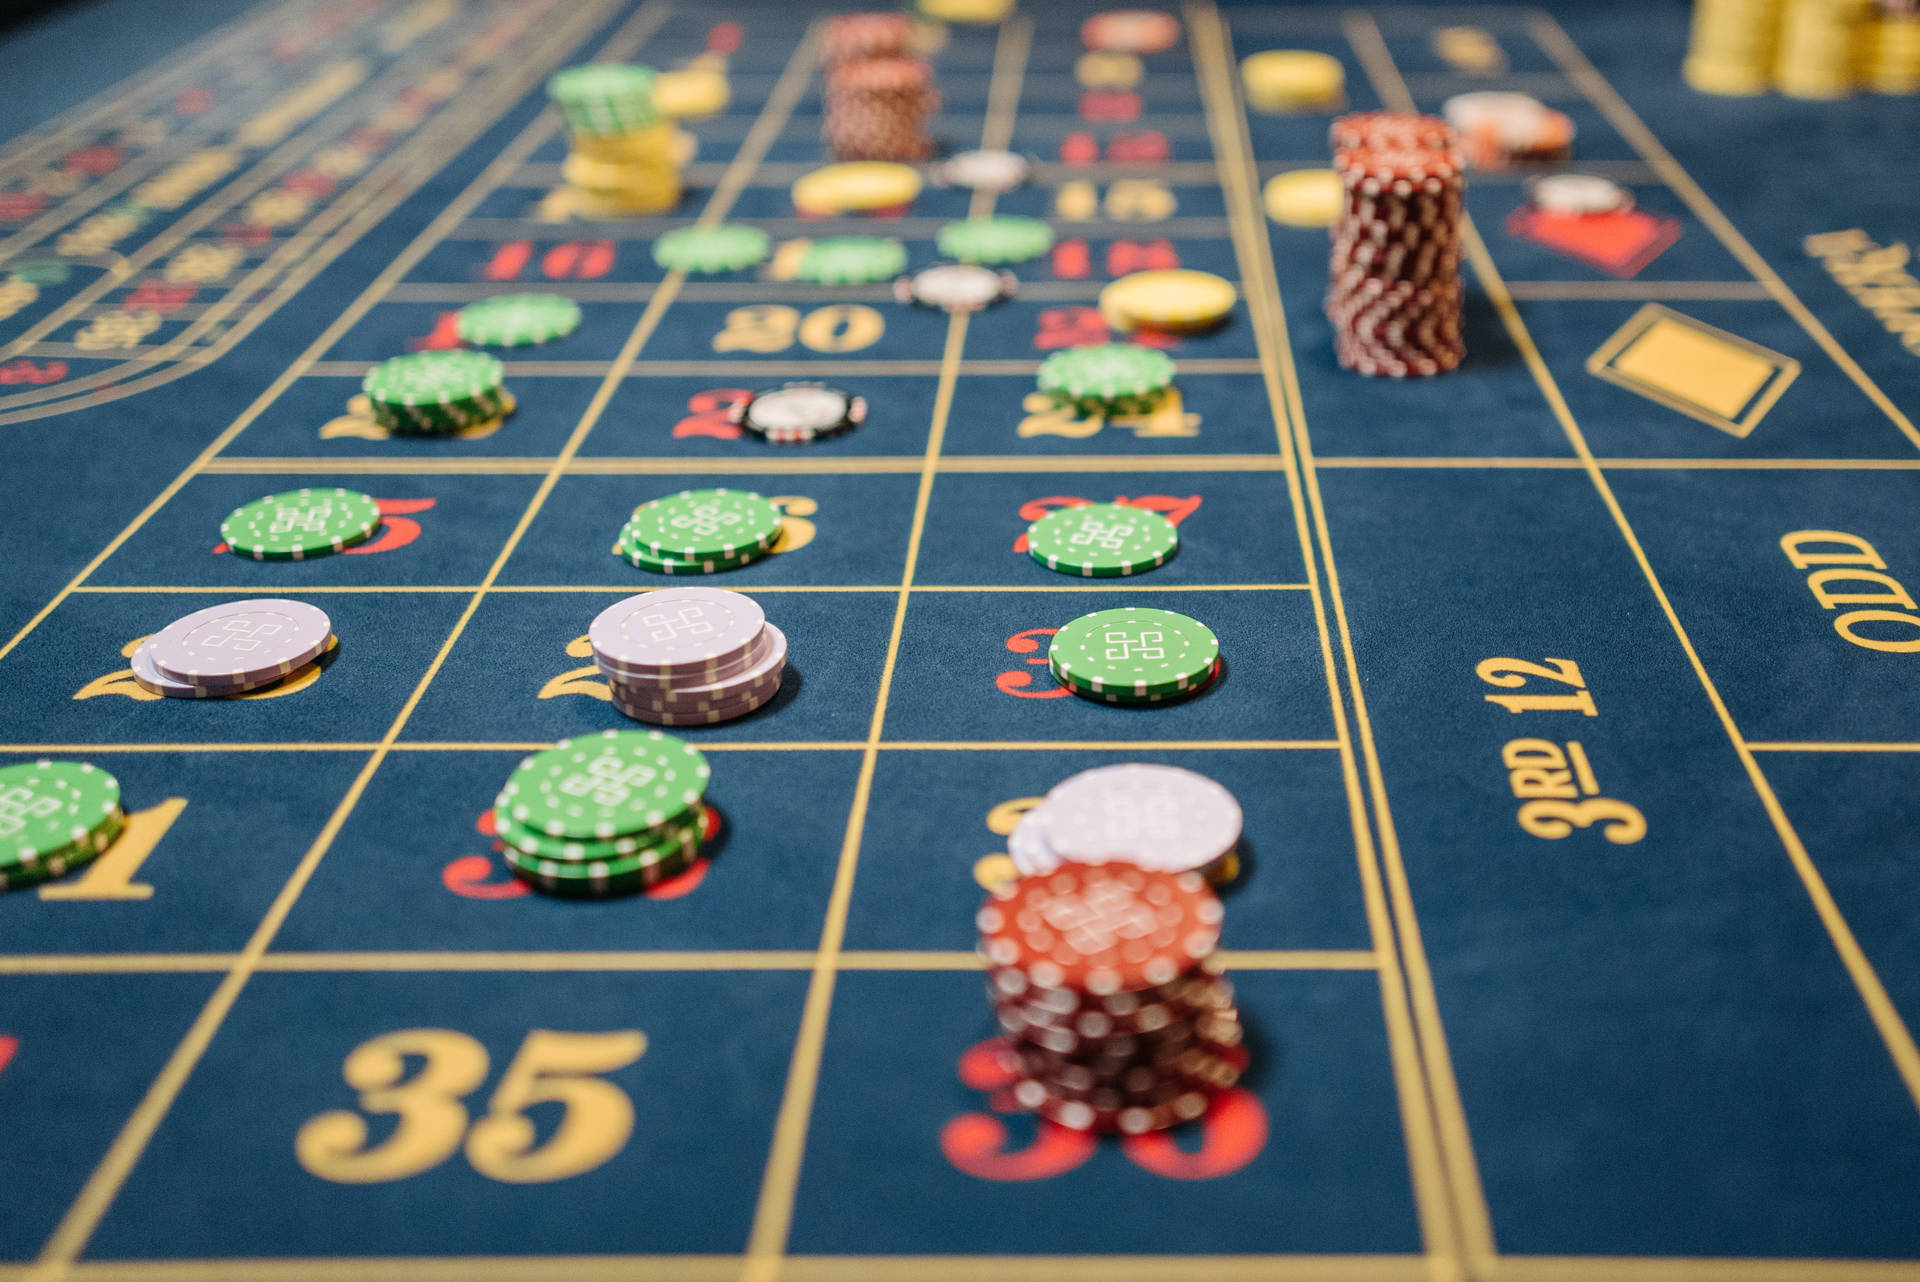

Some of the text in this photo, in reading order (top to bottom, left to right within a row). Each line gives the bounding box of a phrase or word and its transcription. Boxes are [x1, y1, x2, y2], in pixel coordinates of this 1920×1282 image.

[713, 304, 885, 353] 20
[1779, 529, 1920, 653] ODD
[1474, 656, 1599, 716] 12
[295, 1027, 650, 1184] 35
